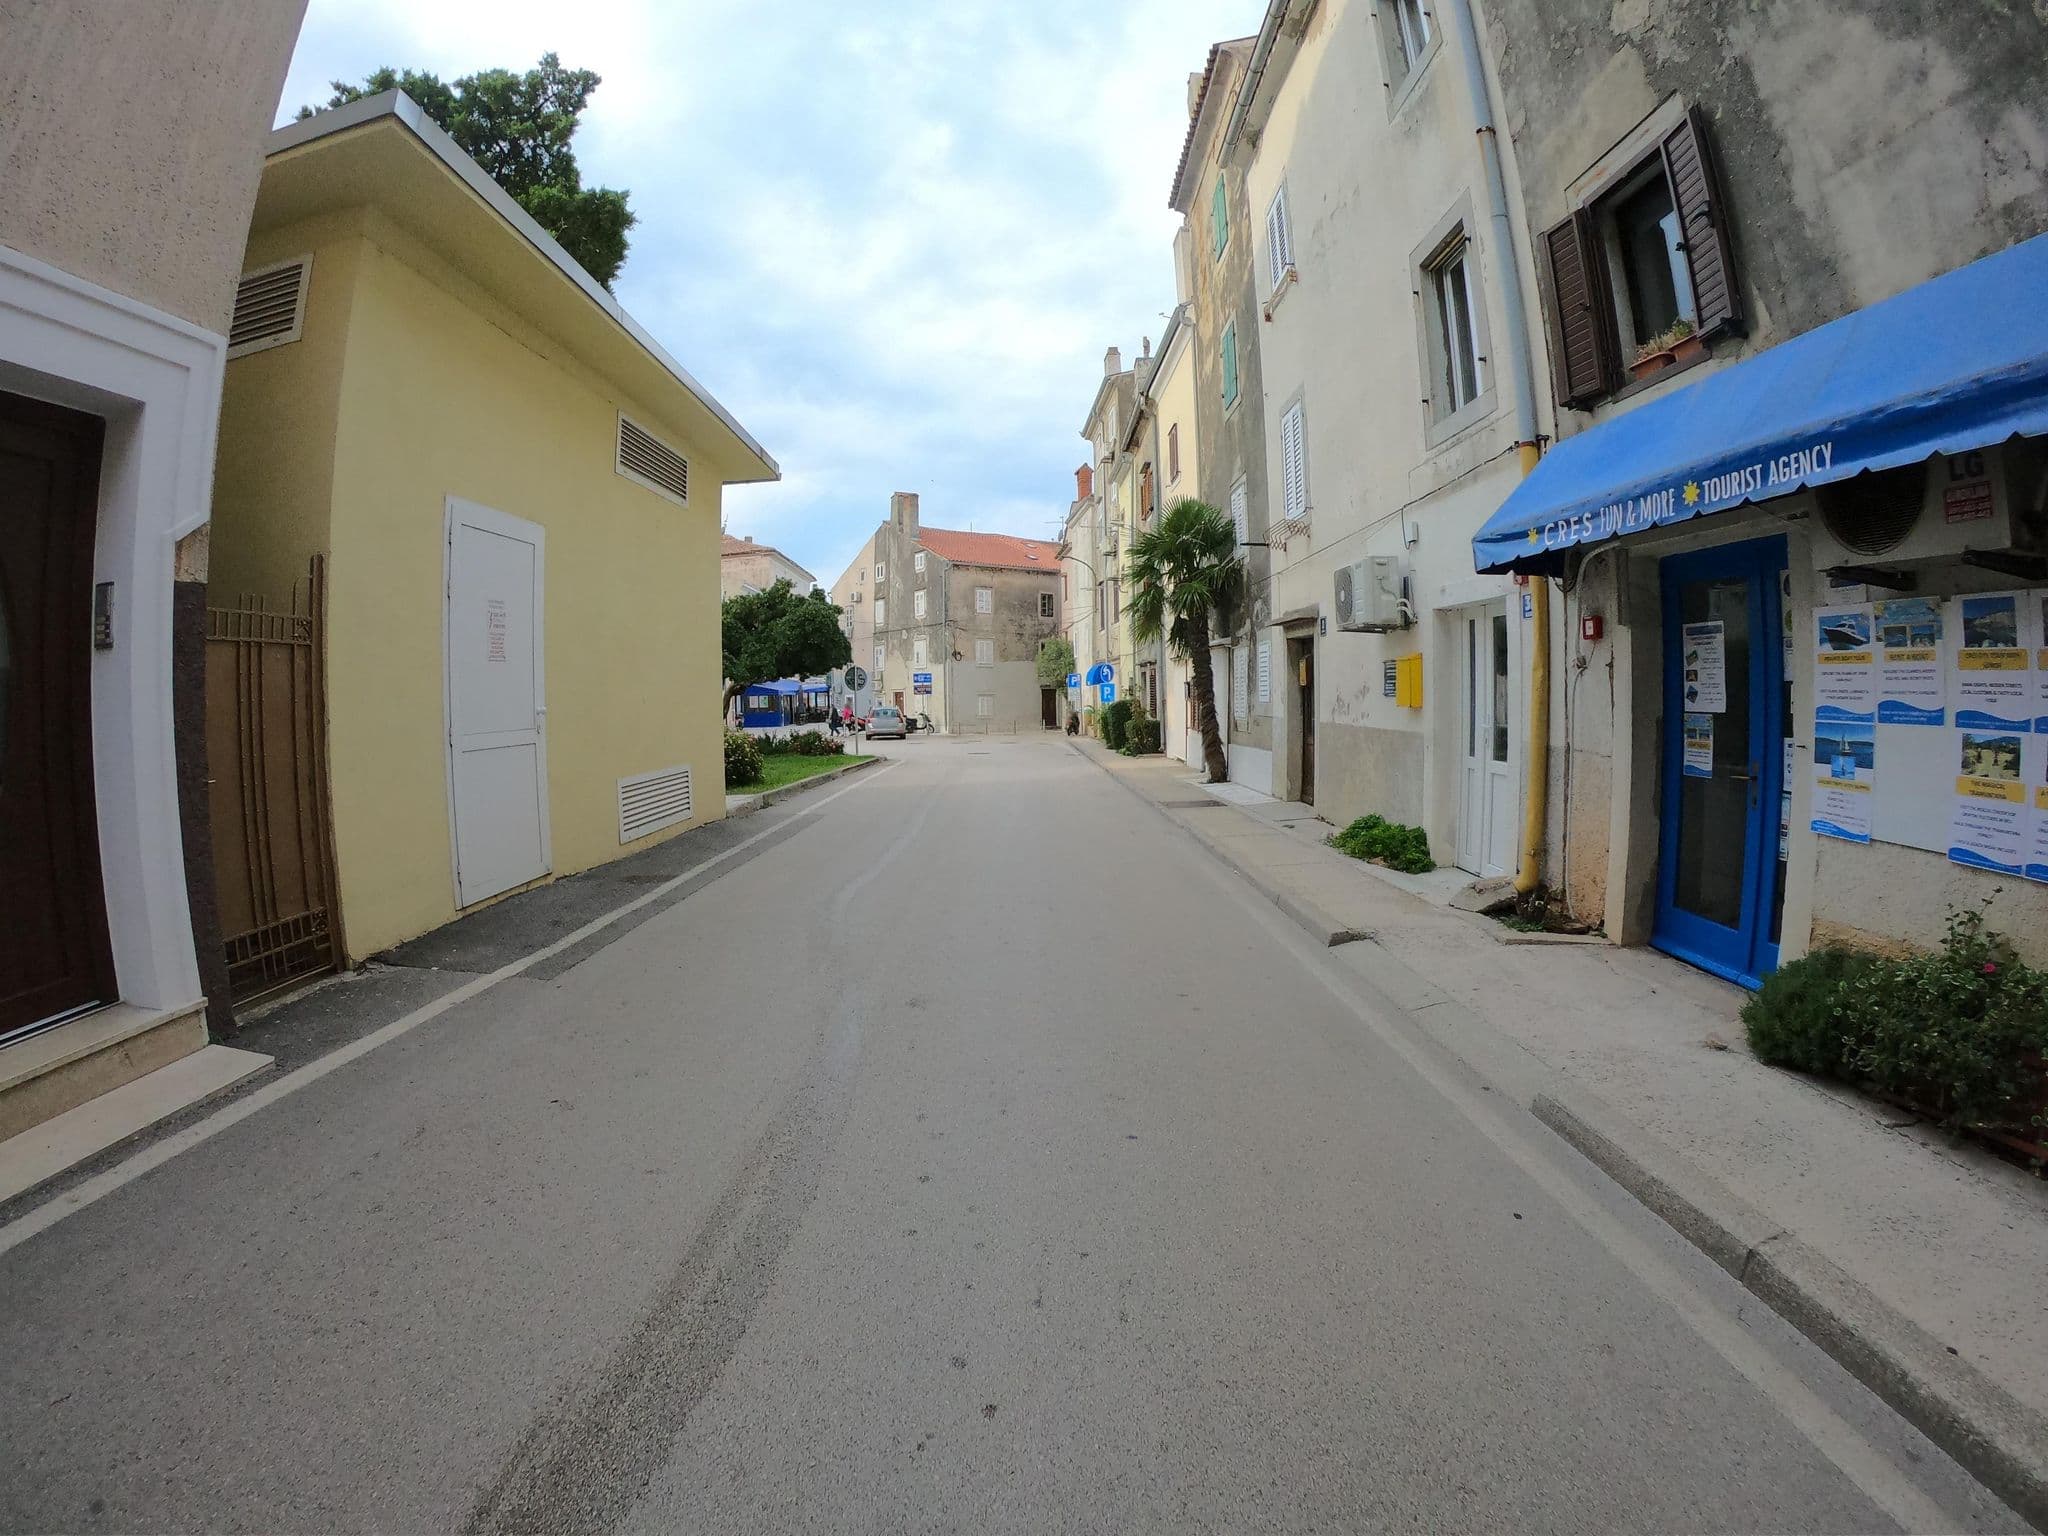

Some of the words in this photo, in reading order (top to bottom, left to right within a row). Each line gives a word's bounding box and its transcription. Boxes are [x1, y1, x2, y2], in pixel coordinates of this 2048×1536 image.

[1544, 512, 1592, 546] CRES
[1600, 503, 1623, 533] FUN
[1627, 500, 1637, 527] &
[1640, 488, 1676, 523] MORE
[1702, 463, 1763, 504] TOURIST
[1768, 441, 1833, 487] AGENCY
[1950, 453, 1984, 481] LG
